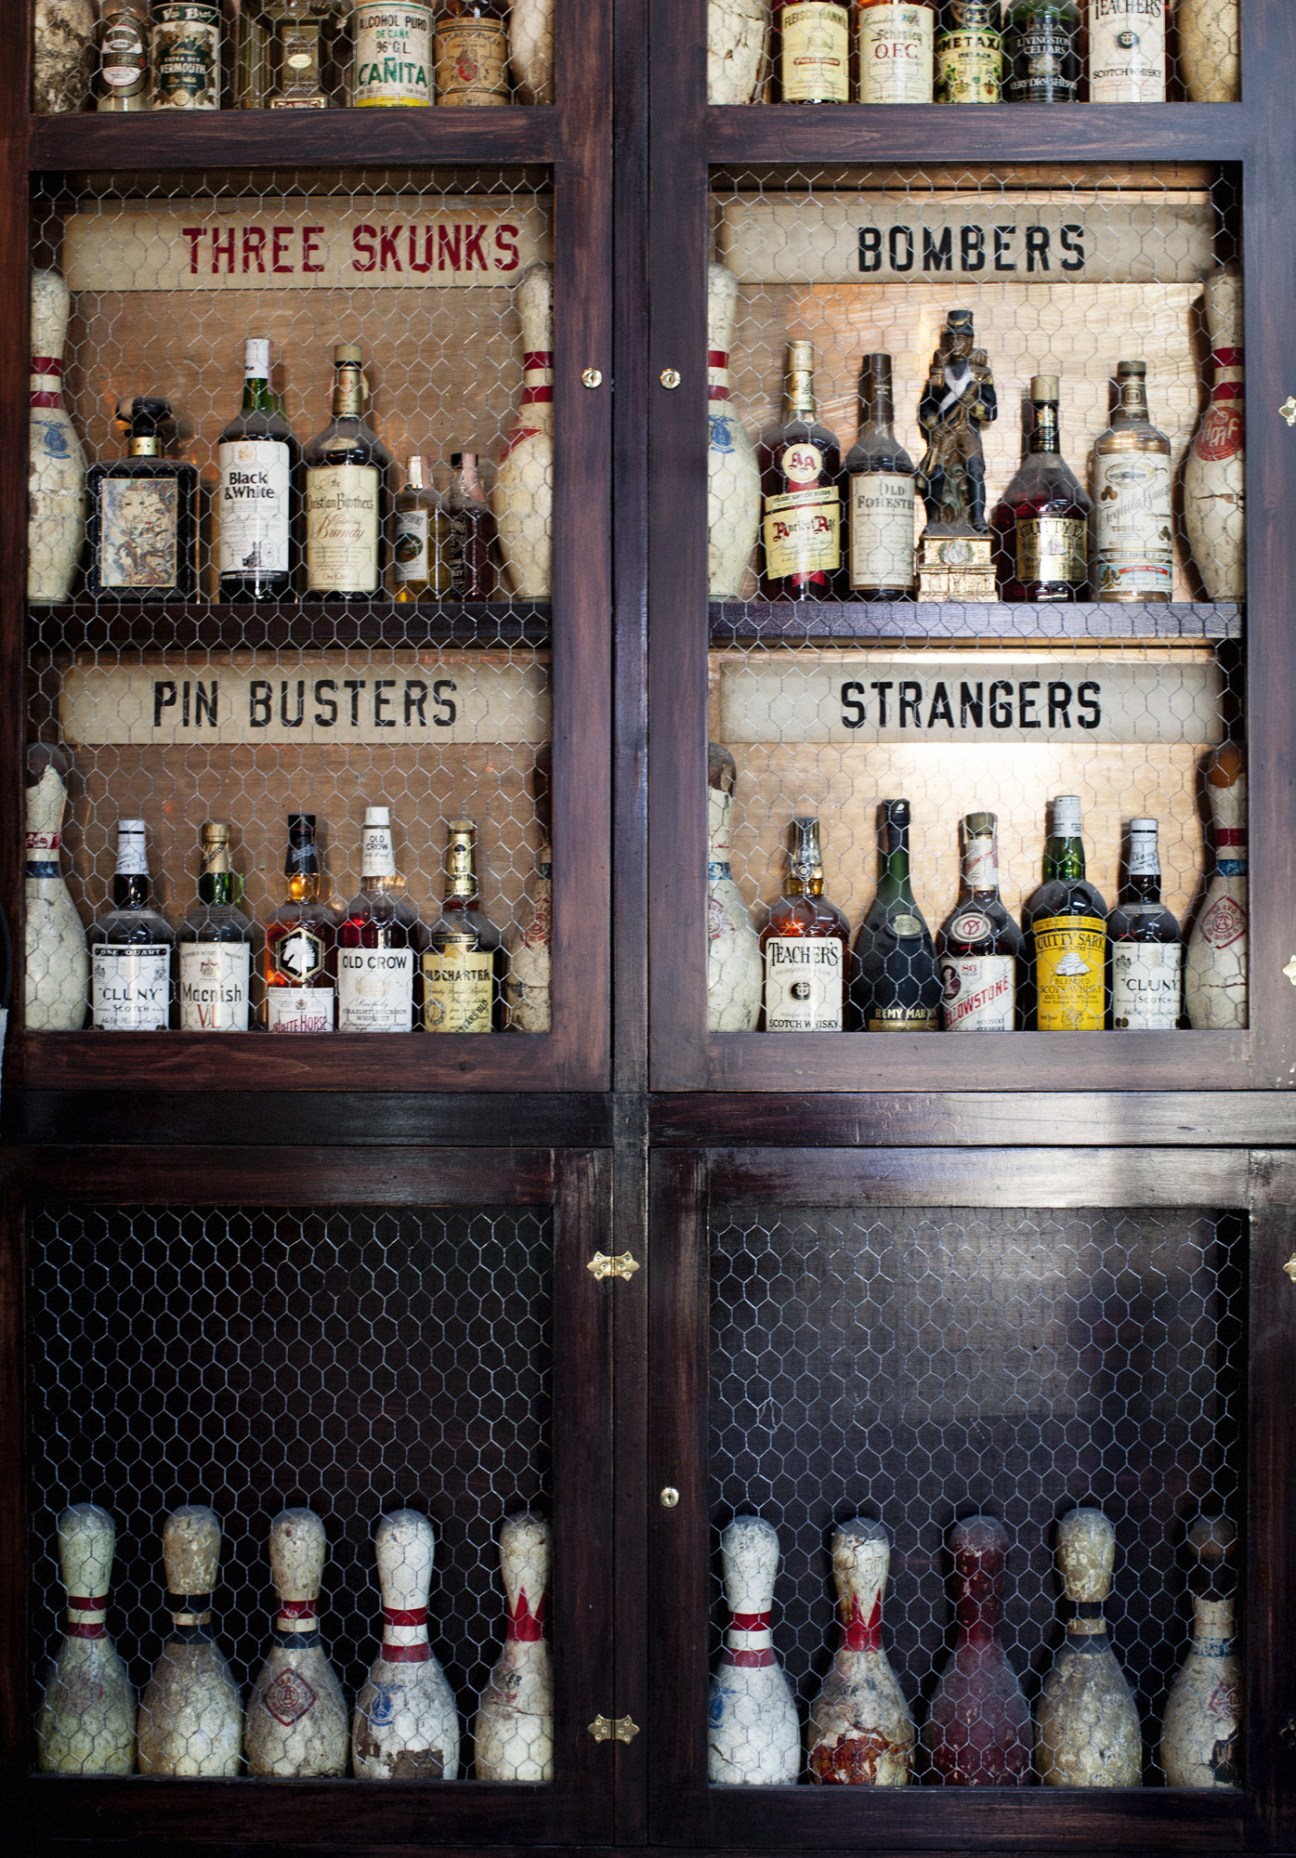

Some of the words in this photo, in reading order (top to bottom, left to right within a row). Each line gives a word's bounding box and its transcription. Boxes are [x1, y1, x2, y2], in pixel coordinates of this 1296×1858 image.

[359, 14, 400, 30] ALCOHOL
[405, 15, 427, 32] PURO
[376, 29, 385, 39] DE
[1024, 45, 1066, 54] CELLARS
[159, 63, 206, 74] VERMOUTH
[358, 57, 427, 88] CAÑITA
[183, 226, 324, 273] THREE
[352, 224, 521, 273] SKUNKS
[857, 223, 1086, 273] BOMBERS
[229, 471, 268, 486] Black
[880, 482, 905, 498] OLD
[317, 514, 365, 543] Brandy
[154, 680, 218, 728] PIN
[249, 679, 458, 728] BUSTERS
[840, 680, 1102, 729] STRANGERS
[1037, 932, 1074, 949] CUTTY
[342, 955, 363, 969] OLD
[367, 955, 407, 969] CROW
[769, 1019, 802, 1029] SCOTCH
